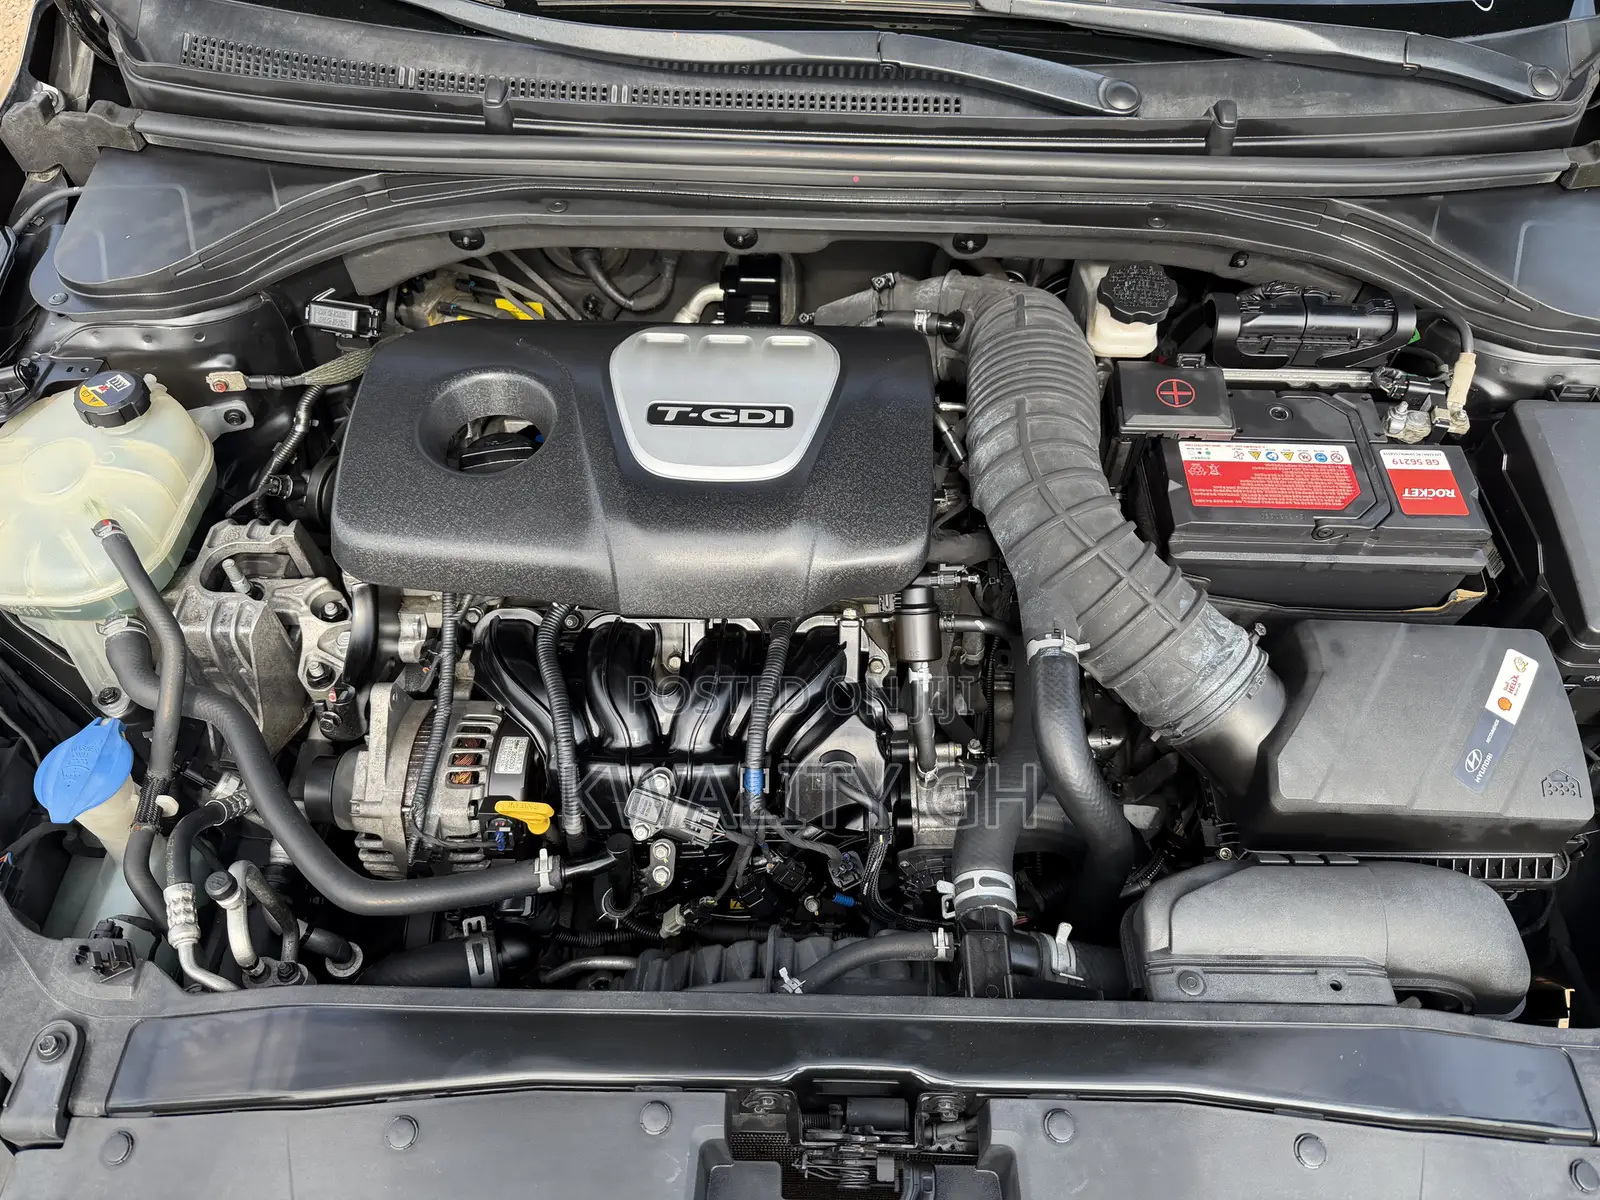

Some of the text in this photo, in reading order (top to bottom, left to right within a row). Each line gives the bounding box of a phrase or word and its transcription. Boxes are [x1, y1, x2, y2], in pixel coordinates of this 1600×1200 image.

[657, 406, 785, 424] T-GDI
[1392, 458, 1440, 466] GB 56219
[1403, 488, 1456, 498] ROCKET
[1507, 674, 1520, 695] HELIX
[1475, 753, 1493, 783] HYUNDAI
